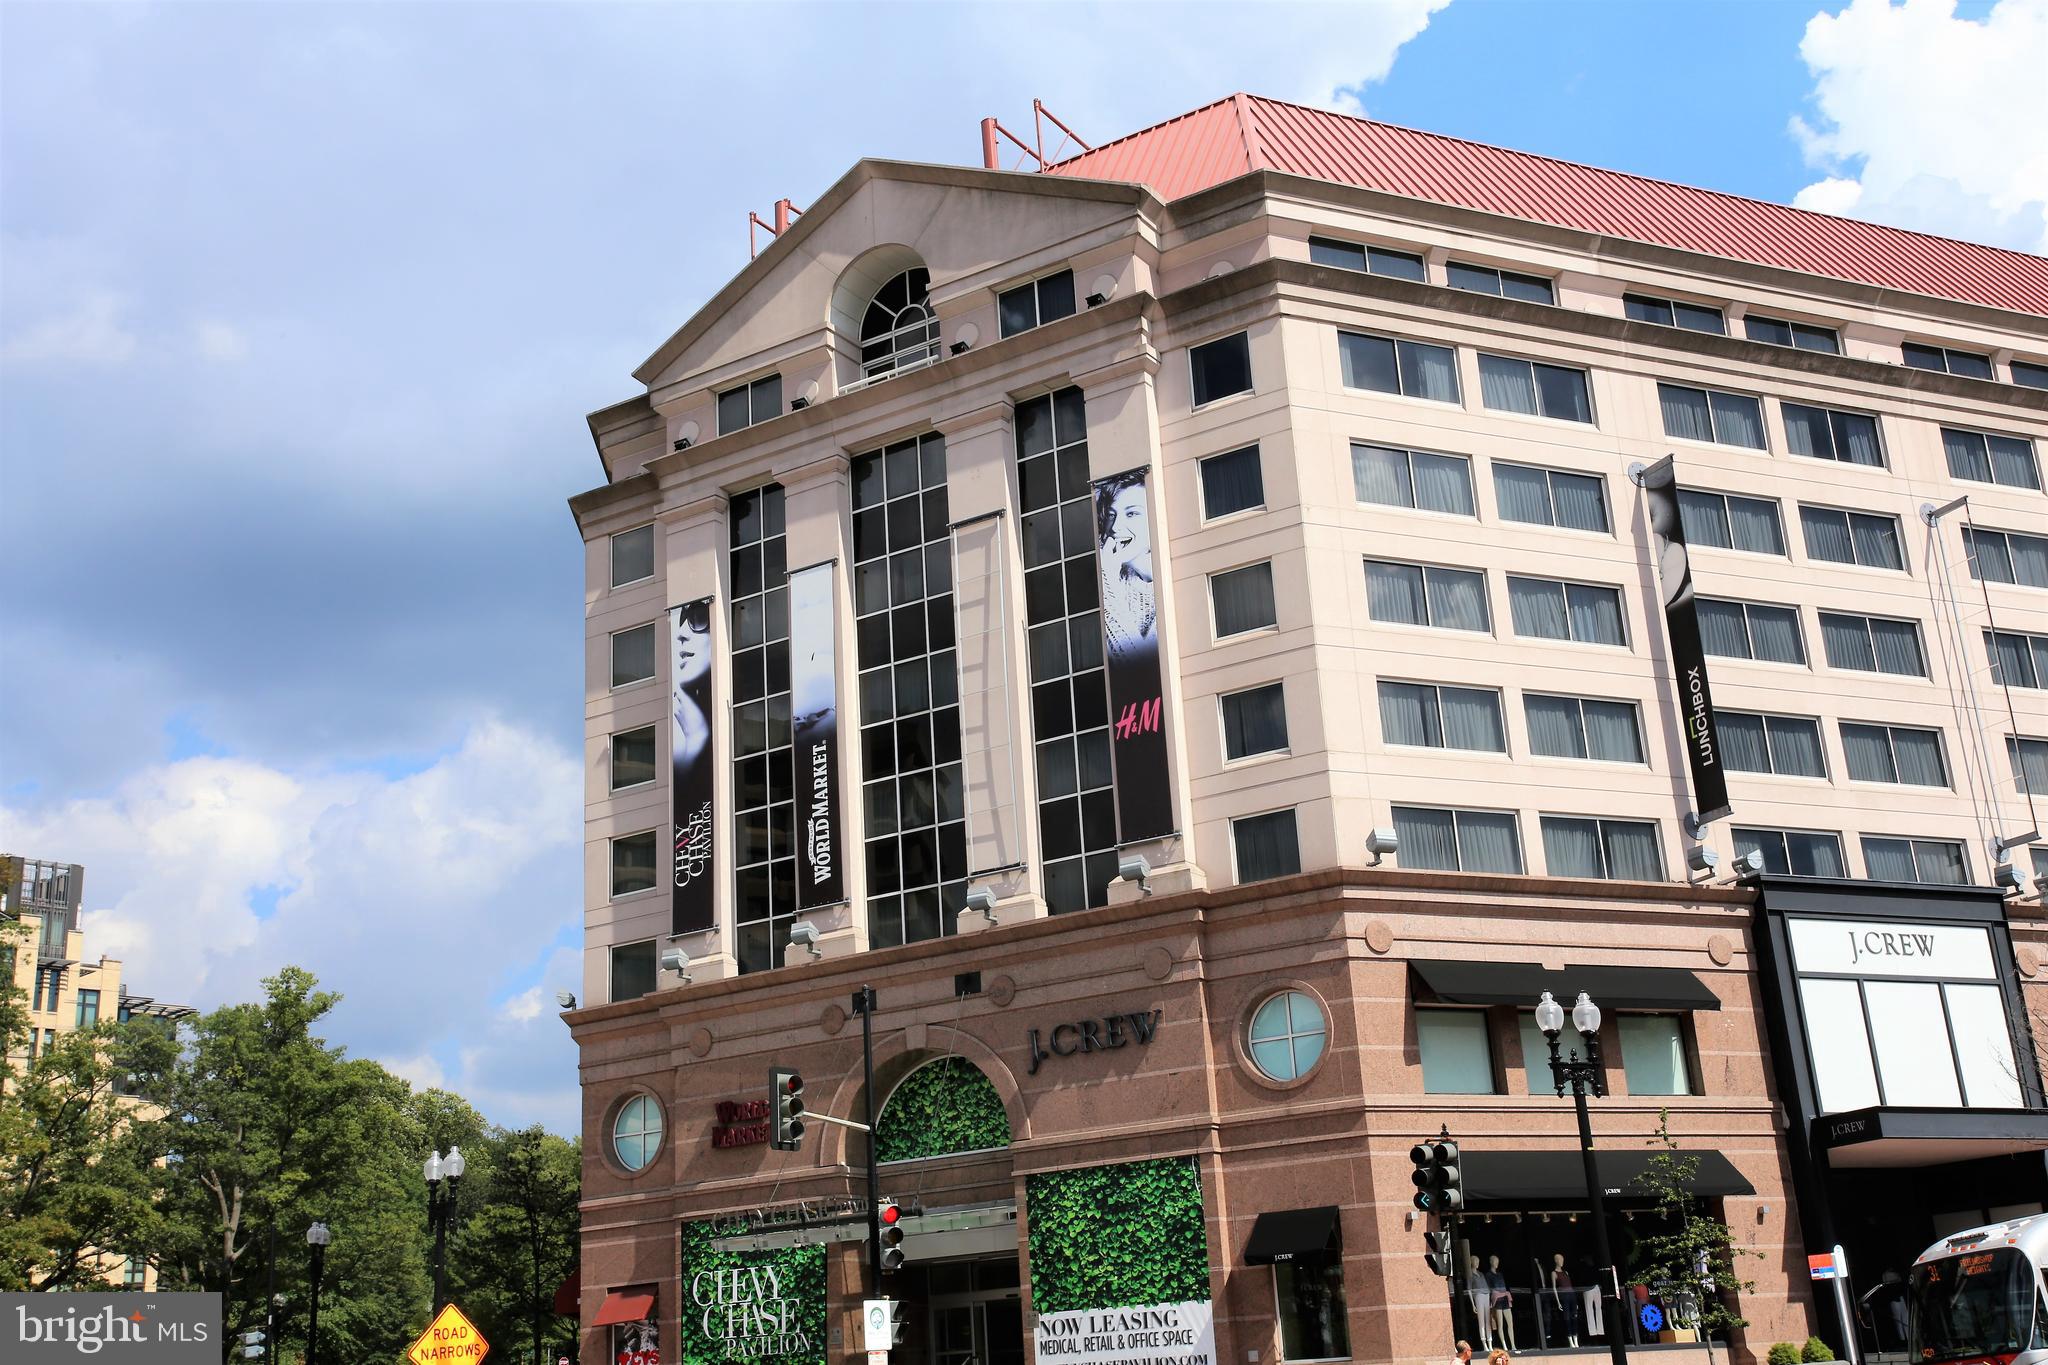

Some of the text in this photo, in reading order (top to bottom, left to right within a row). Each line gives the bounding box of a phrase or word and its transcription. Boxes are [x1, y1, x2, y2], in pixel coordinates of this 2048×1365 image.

[1115, 697, 1160, 740] H&M
[1688, 666, 1714, 767] LUNCHBOX
[702, 801, 711, 859] PAVILION
[812, 743, 832, 885] WORLD MARKET
[675, 823, 690, 887] CHEVY
[689, 810, 704, 877] CHASE
[1849, 931, 1935, 964] J.CREW
[1027, 1008, 1162, 1076] J.CREW
[1831, 1120, 1865, 1138] J.CREW
[692, 1264, 788, 1307] CHEVY
[433, 1326, 468, 1341] ROAD
[703, 1298, 800, 1341] CHASE
[1040, 1309, 1178, 1338] NOW LEASING
[420, 1344, 481, 1360] NARROWS
[726, 1332, 814, 1358] PAVILION
[1040, 1329, 1194, 1356] MEDICAL, RETAIL & OFFICE SPACE
